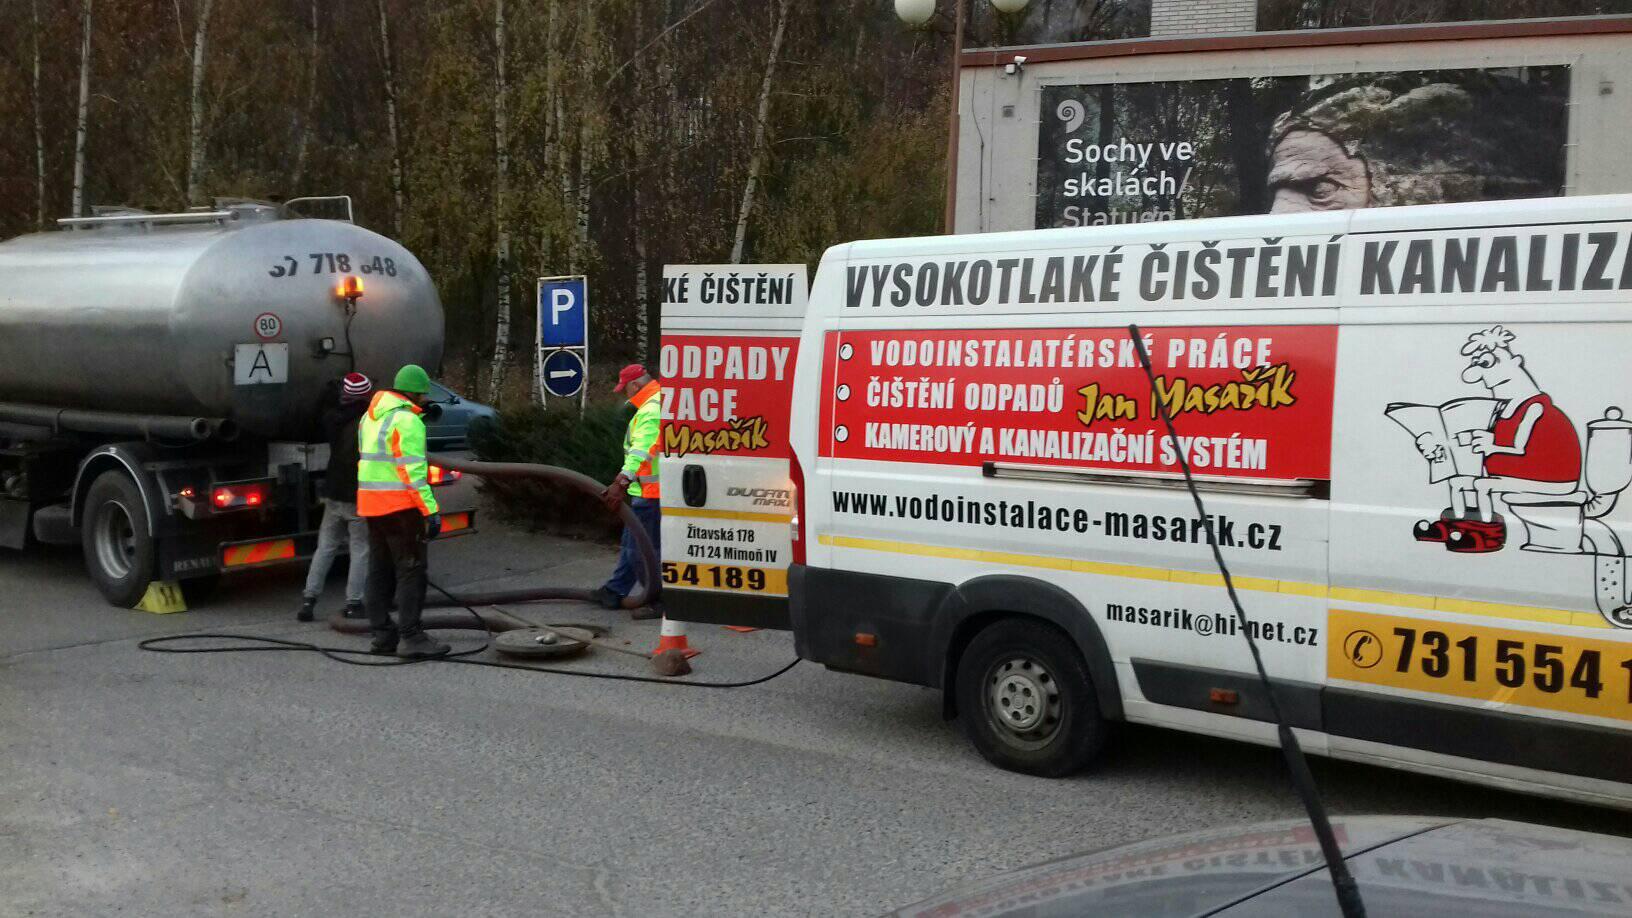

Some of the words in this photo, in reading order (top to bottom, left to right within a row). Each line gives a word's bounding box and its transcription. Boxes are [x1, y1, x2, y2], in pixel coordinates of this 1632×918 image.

[1064, 137, 1153, 168] Sochy
[1160, 141, 1193, 161] ve
[309, 253, 351, 273] 718
[846, 246, 1124, 307] VYSOKOTLAKÉ
[1139, 234, 1345, 301] ČIŠTĚNÍ
[1360, 231, 1632, 295] KANALIZ
[552, 288, 575, 325] P
[700, 273, 794, 305] ČIŠTĚNÍ
[260, 317, 276, 330] 80
[249, 350, 272, 377] A
[660, 344, 790, 381] ODPADY
[1167, 333, 1273, 369] PRÁCE
[661, 387, 738, 422] ZACE
[867, 375, 956, 409] ČIŠTĚNÍ
[964, 377, 1064, 413] ODPADŮ
[1077, 383, 1138, 427] Jan
[865, 421, 976, 454] KAMEROVÝ
[979, 427, 994, 455] A
[999, 427, 1156, 464] KANALIZAČNÍ
[1159, 432, 1268, 470] SYSTÉM
[687, 523, 734, 541] Žitavská
[737, 529, 755, 543] 178
[833, 491, 1282, 551] www.vodoinstalace-masarik.cz
[687, 544, 705, 558] 471
[707, 546, 721, 559] 24
[723, 546, 763, 562] Mimoň
[766, 550, 778, 563] IV
[662, 562, 699, 585] 54
[708, 566, 765, 591] 189
[1106, 603, 1318, 646] masarik@hi-net.cz
[1393, 627, 1478, 682] 731
[1495, 639, 1604, 699] 554
